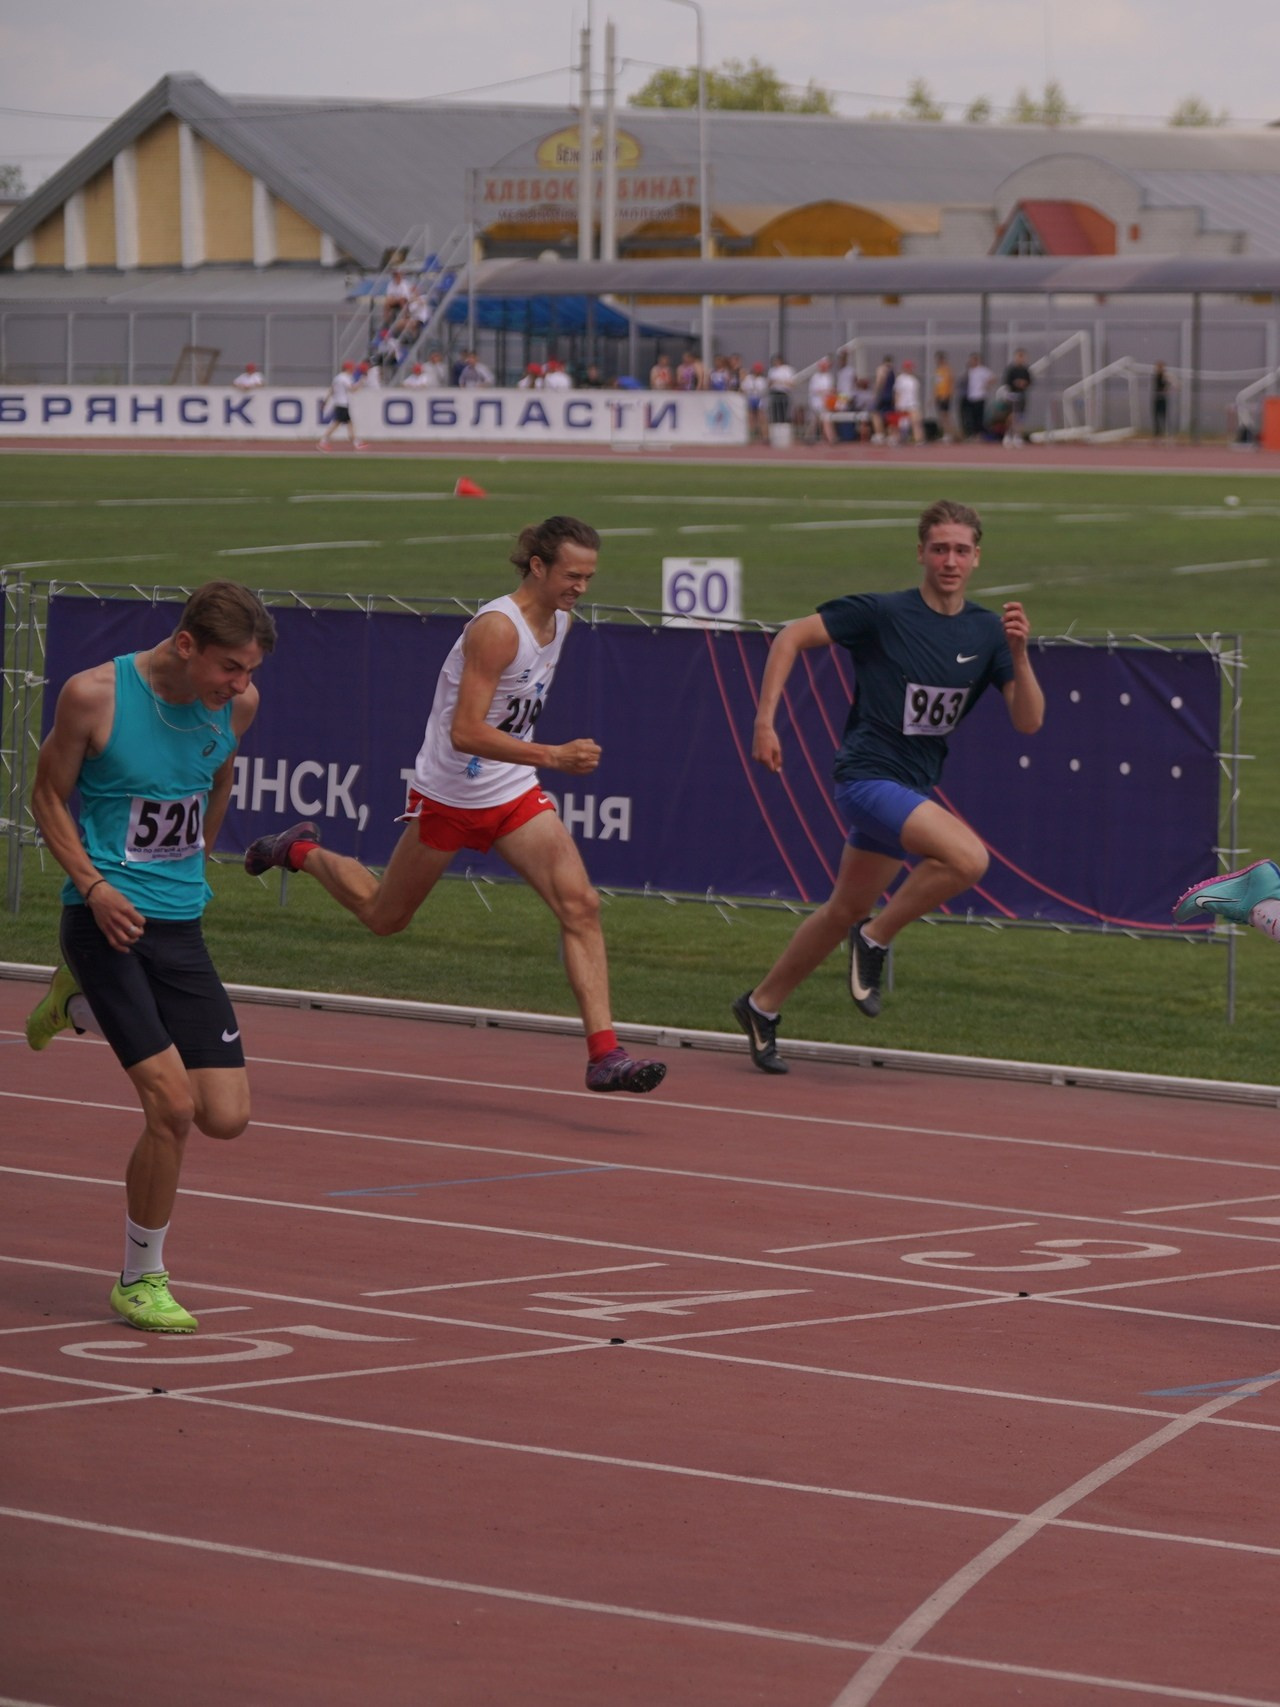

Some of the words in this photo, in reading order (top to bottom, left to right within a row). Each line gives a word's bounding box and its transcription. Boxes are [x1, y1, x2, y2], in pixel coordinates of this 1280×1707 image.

[484, 177, 697, 203] ХЛЕБОКБИНАТ
[383, 398, 677, 429] ОБЛАСТИ
[668, 569, 728, 615] 60
[911, 688, 963, 726] 963
[133, 799, 200, 848] 520
[900, 1238, 1182, 1272] 3
[521, 1289, 815, 1322] 4
[58, 1324, 417, 1364] 5
